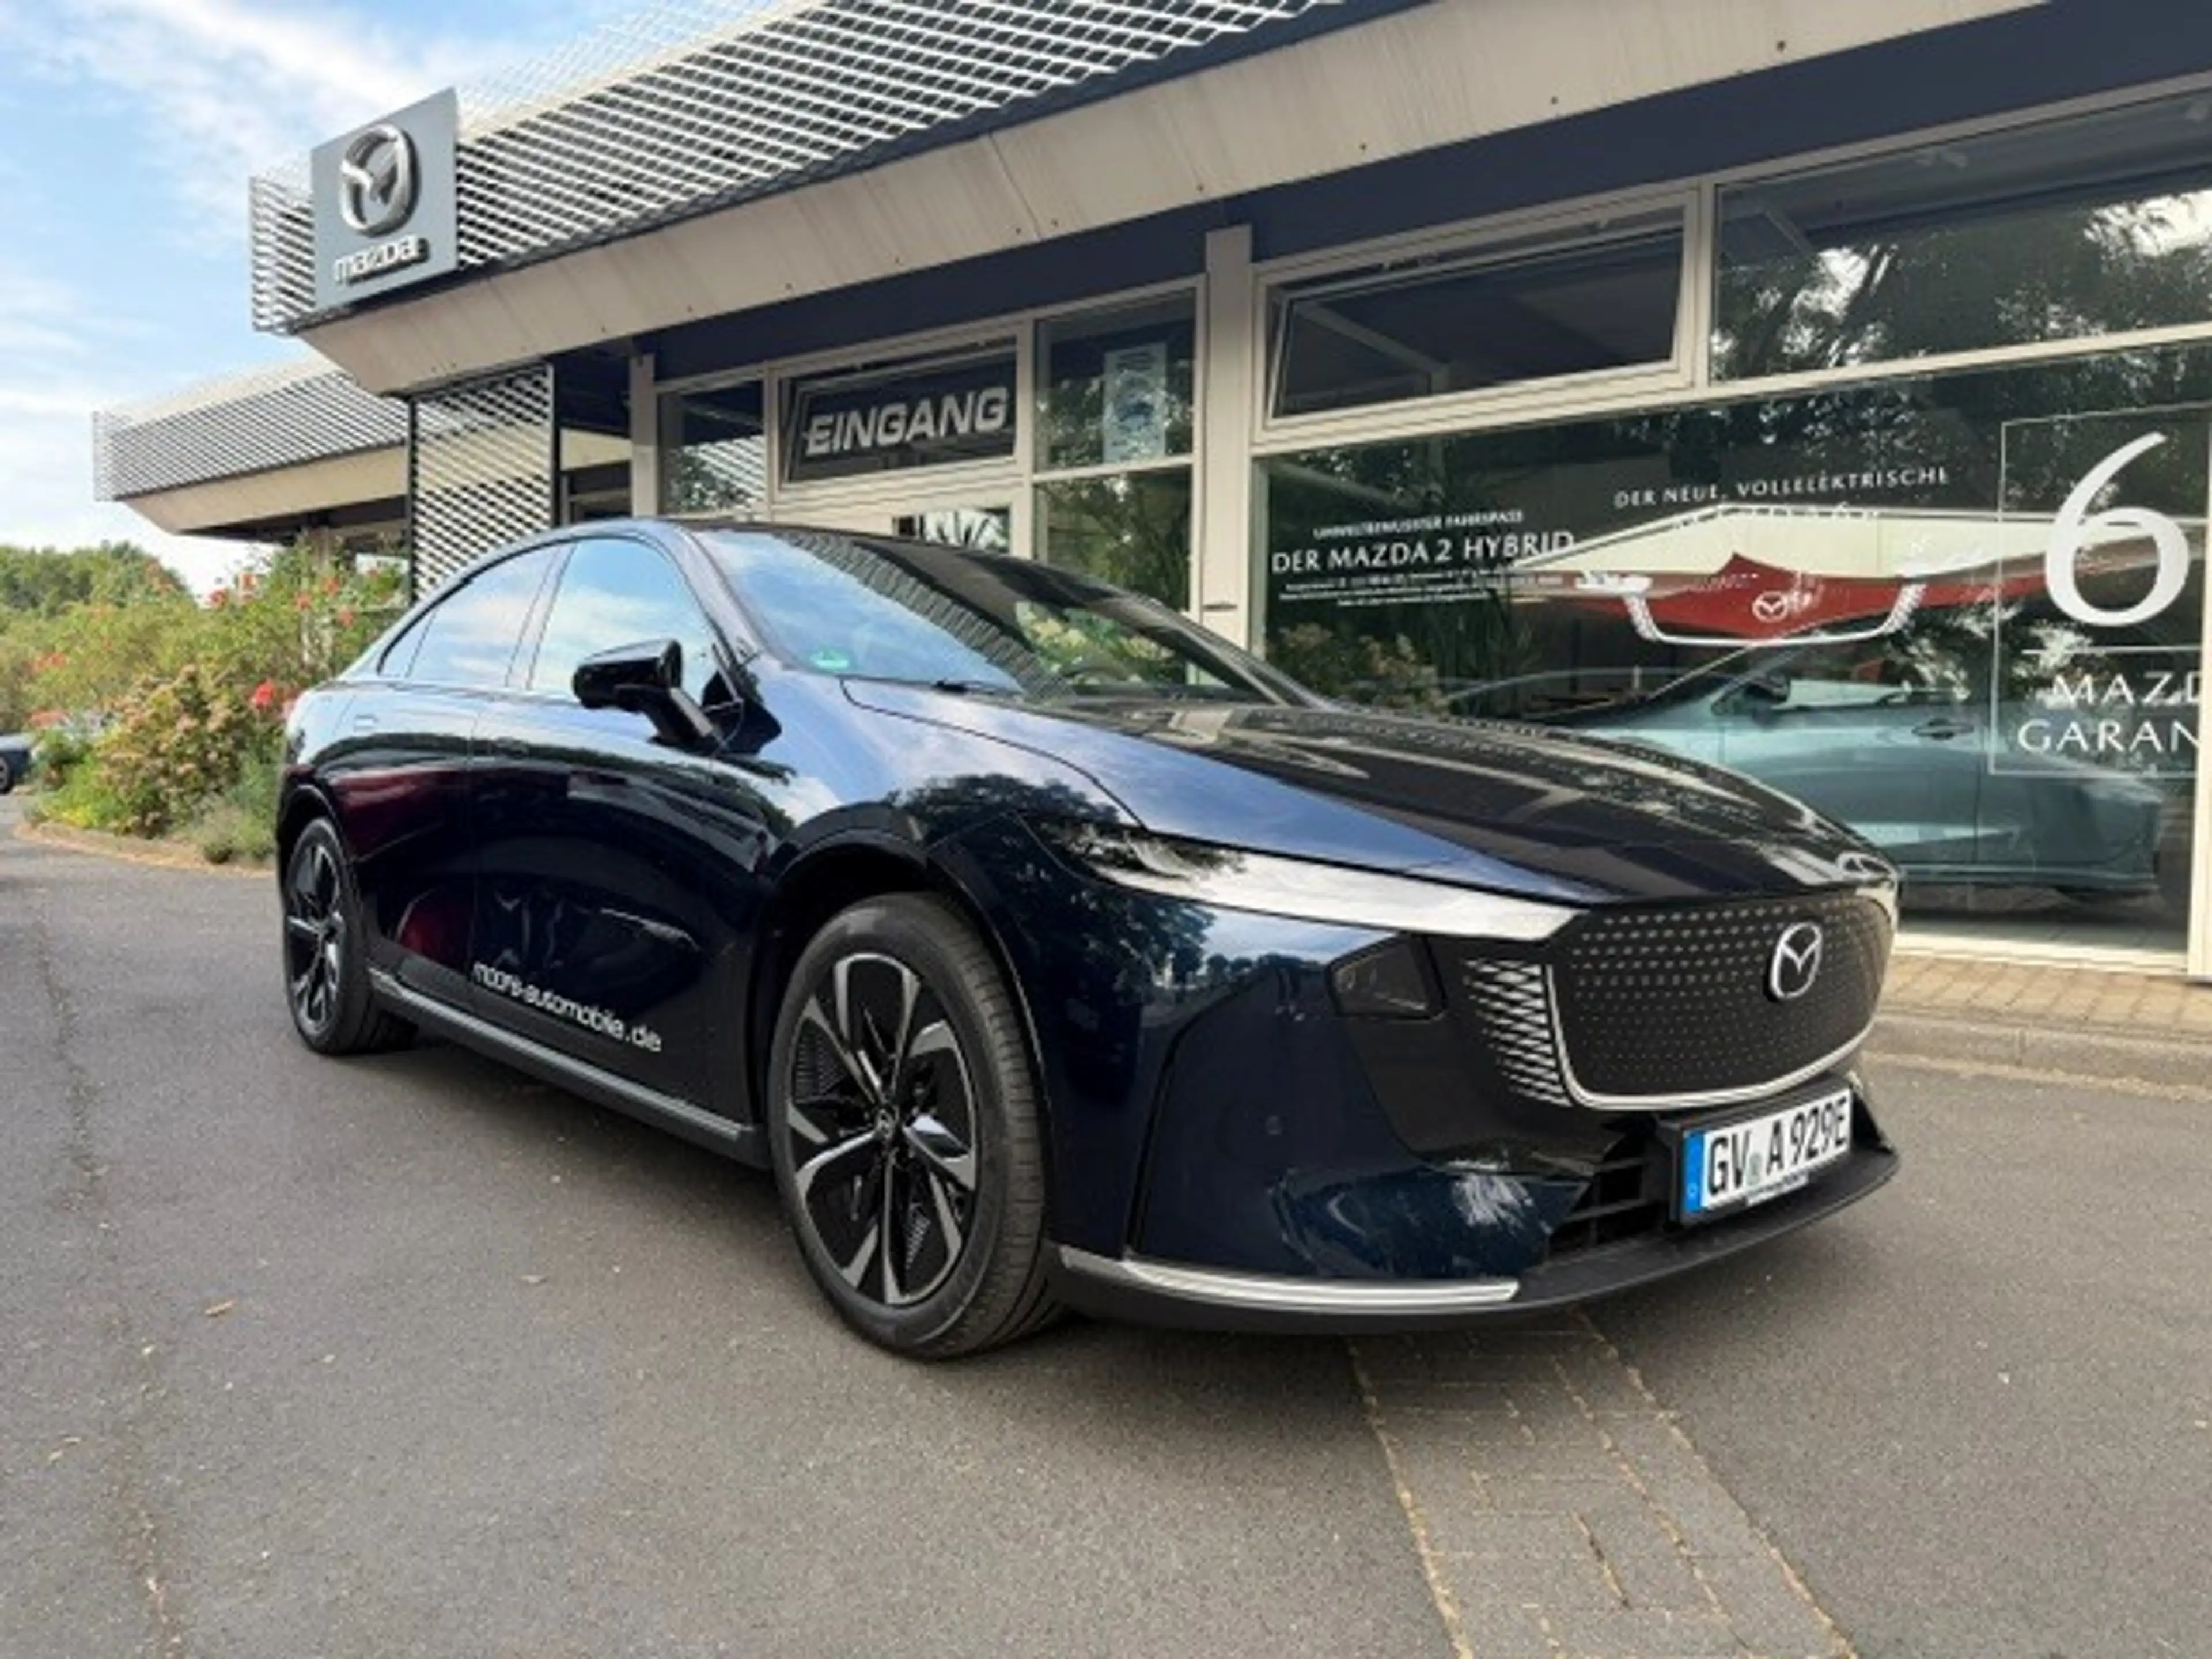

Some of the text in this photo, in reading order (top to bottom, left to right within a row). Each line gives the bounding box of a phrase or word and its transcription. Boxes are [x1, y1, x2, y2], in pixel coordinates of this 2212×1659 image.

[334, 235, 422, 285] mazda
[805, 387, 1009, 456] EINGANG
[1615, 490, 1656, 508] DER
[1736, 467, 1948, 498] VOLLELEKTRISCHE
[1271, 530, 1575, 574] DER MAZDA 2 HYBRID
[2046, 431, 2190, 627] 6
[1707, 1130, 1751, 1197] GV
[1766, 1120, 1785, 1176] A
[1790, 1096, 1847, 1165] 929E
